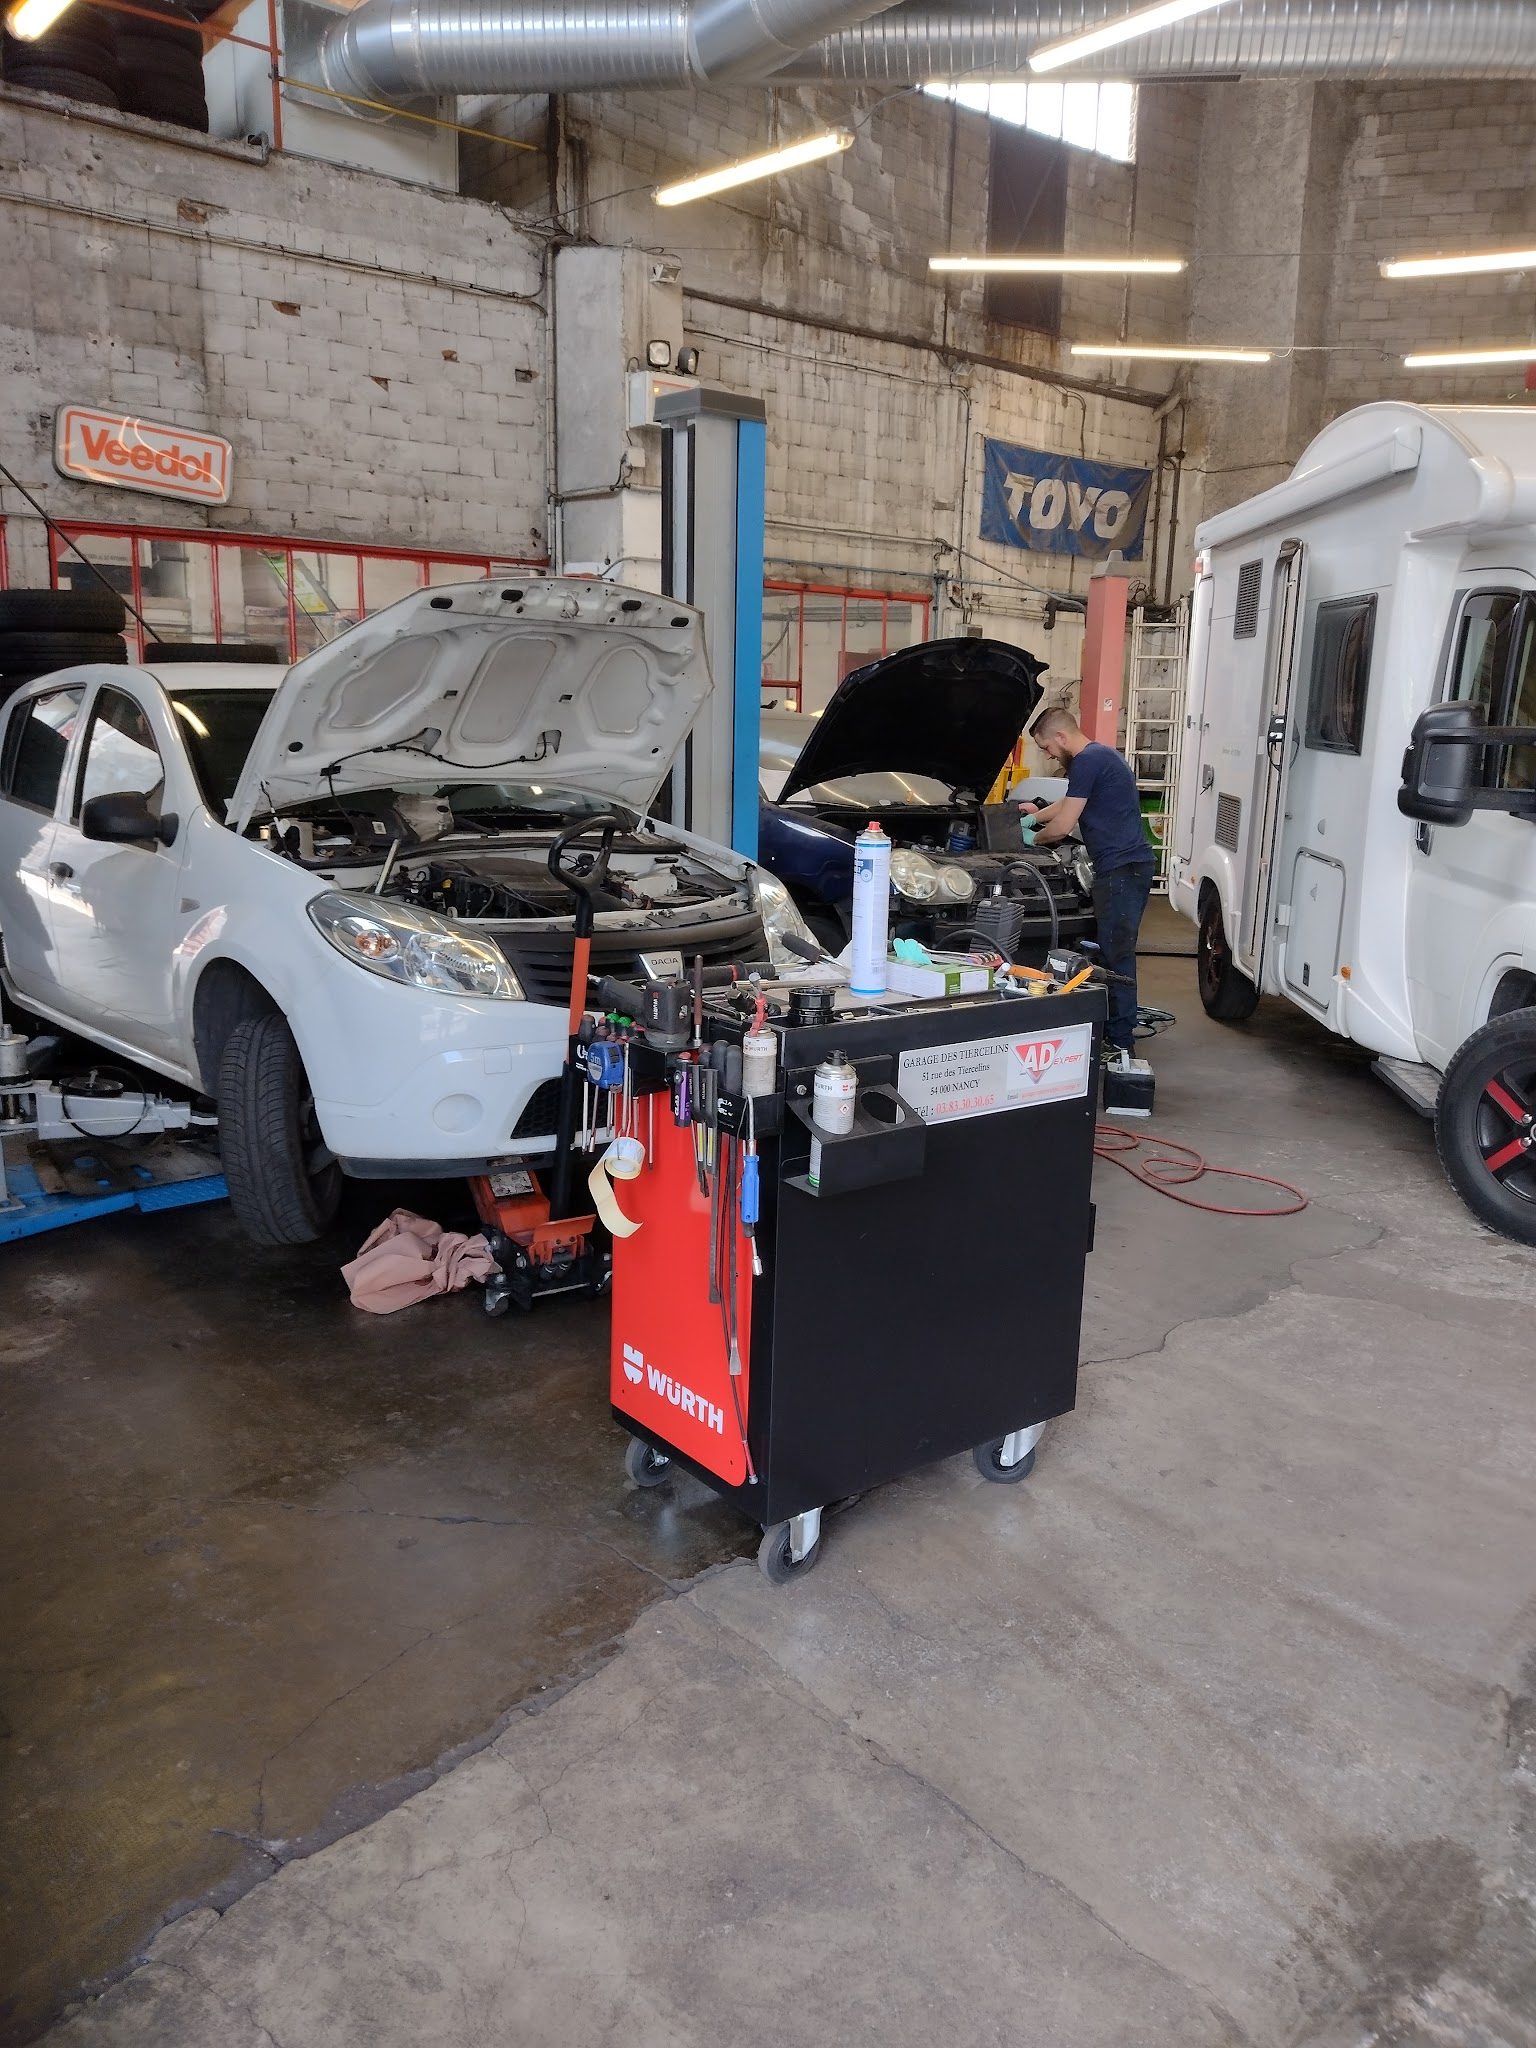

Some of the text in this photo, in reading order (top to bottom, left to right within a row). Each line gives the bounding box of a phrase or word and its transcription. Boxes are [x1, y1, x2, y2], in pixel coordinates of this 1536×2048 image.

[80, 424, 212, 483] Veedol
[1003, 471, 1132, 539] TOYO
[652, 957, 679, 966] DACIA
[903, 1044, 1009, 1069] GARAGE DES TIERCELINS
[1024, 1043, 1056, 1072] AD
[1054, 1054, 1084, 1066] EXPERT
[922, 1063, 990, 1081] 51 rue des Tiercelins
[930, 1079, 981, 1096] 54 000 NANCY
[935, 1094, 995, 1114] 03.83.30.30.65
[647, 1364, 724, 1435] WÜRTH
